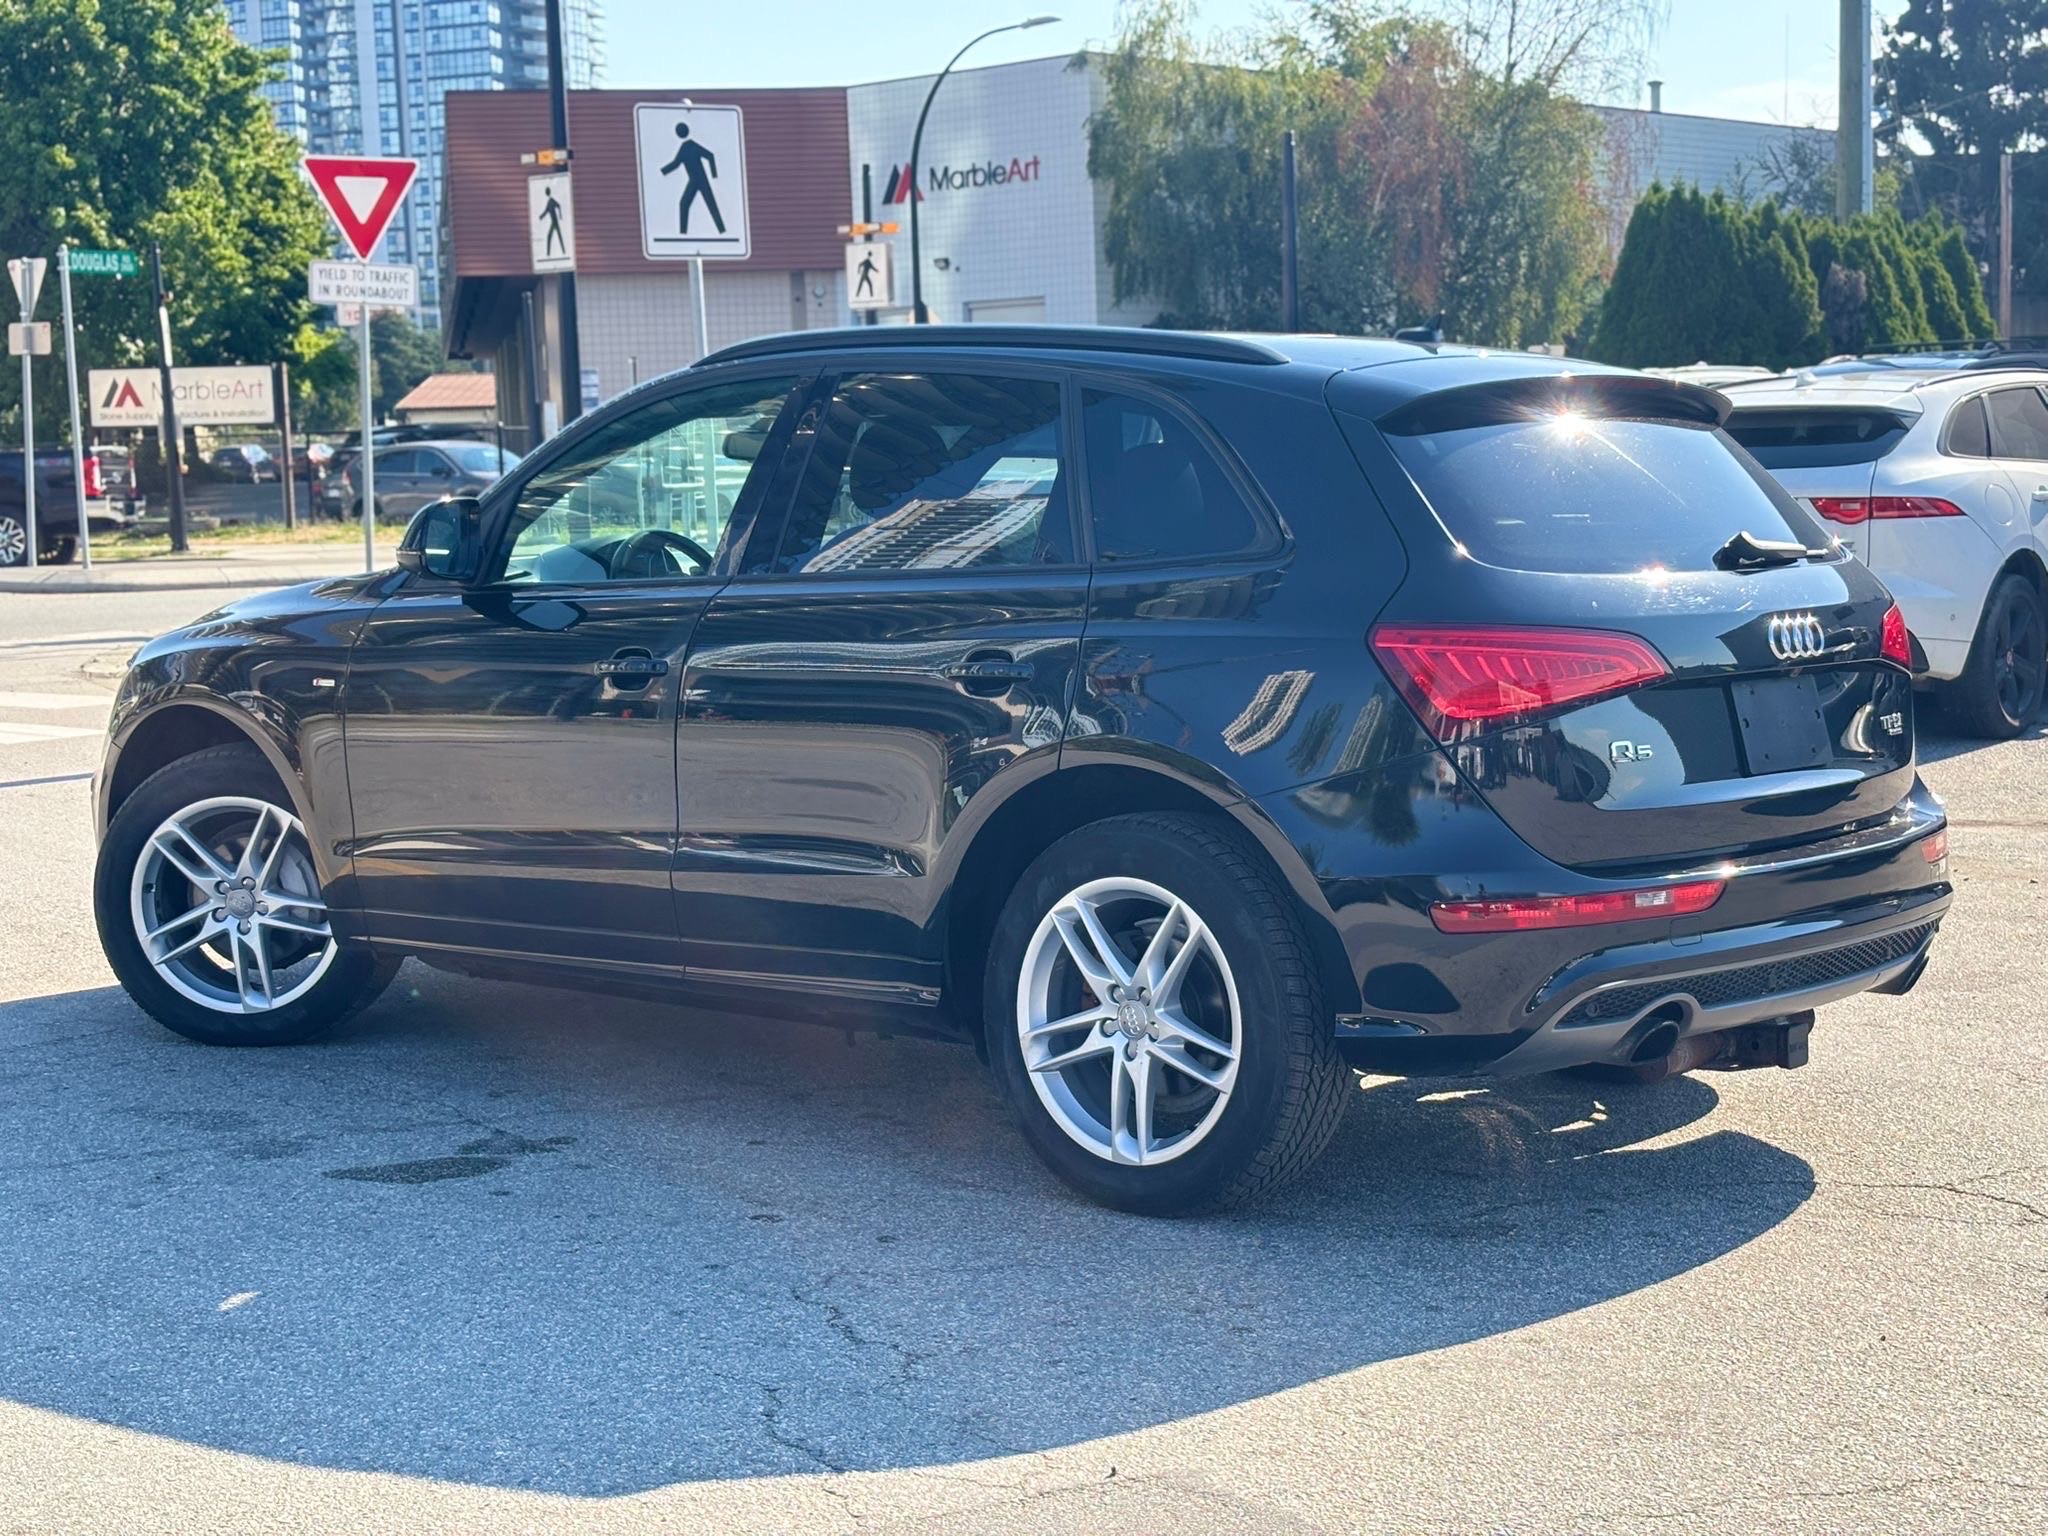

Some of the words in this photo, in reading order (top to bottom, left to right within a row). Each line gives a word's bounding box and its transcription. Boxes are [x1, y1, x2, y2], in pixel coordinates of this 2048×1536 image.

[930, 155, 1040, 192] MarbleArt
[71, 252, 119, 271] DOUGLAS
[318, 267, 347, 281] YIELD
[352, 269, 366, 281] TO
[370, 270, 410, 284] TRAFFIC
[317, 284, 330, 296] IN
[335, 285, 410, 299] ROUNDABOUT
[1610, 740, 1653, 763] Q5
